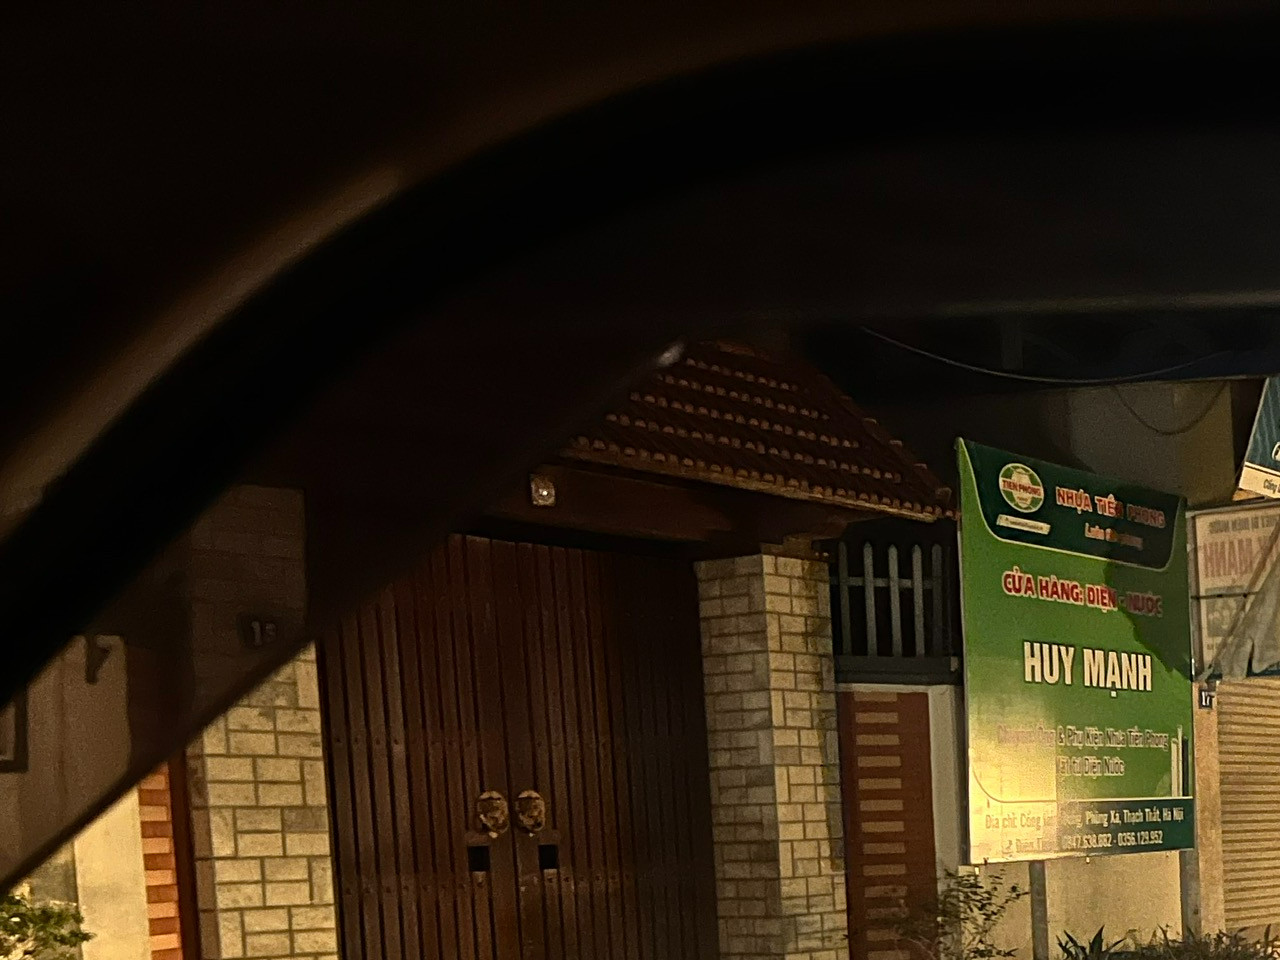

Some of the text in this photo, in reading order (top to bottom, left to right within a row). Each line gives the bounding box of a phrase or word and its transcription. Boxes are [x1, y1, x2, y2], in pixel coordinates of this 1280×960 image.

[1056, 486, 1093, 515] NHỰA
[1003, 566, 1036, 598] CỬA
[1023, 642, 1152, 697] HUY MẠNH
